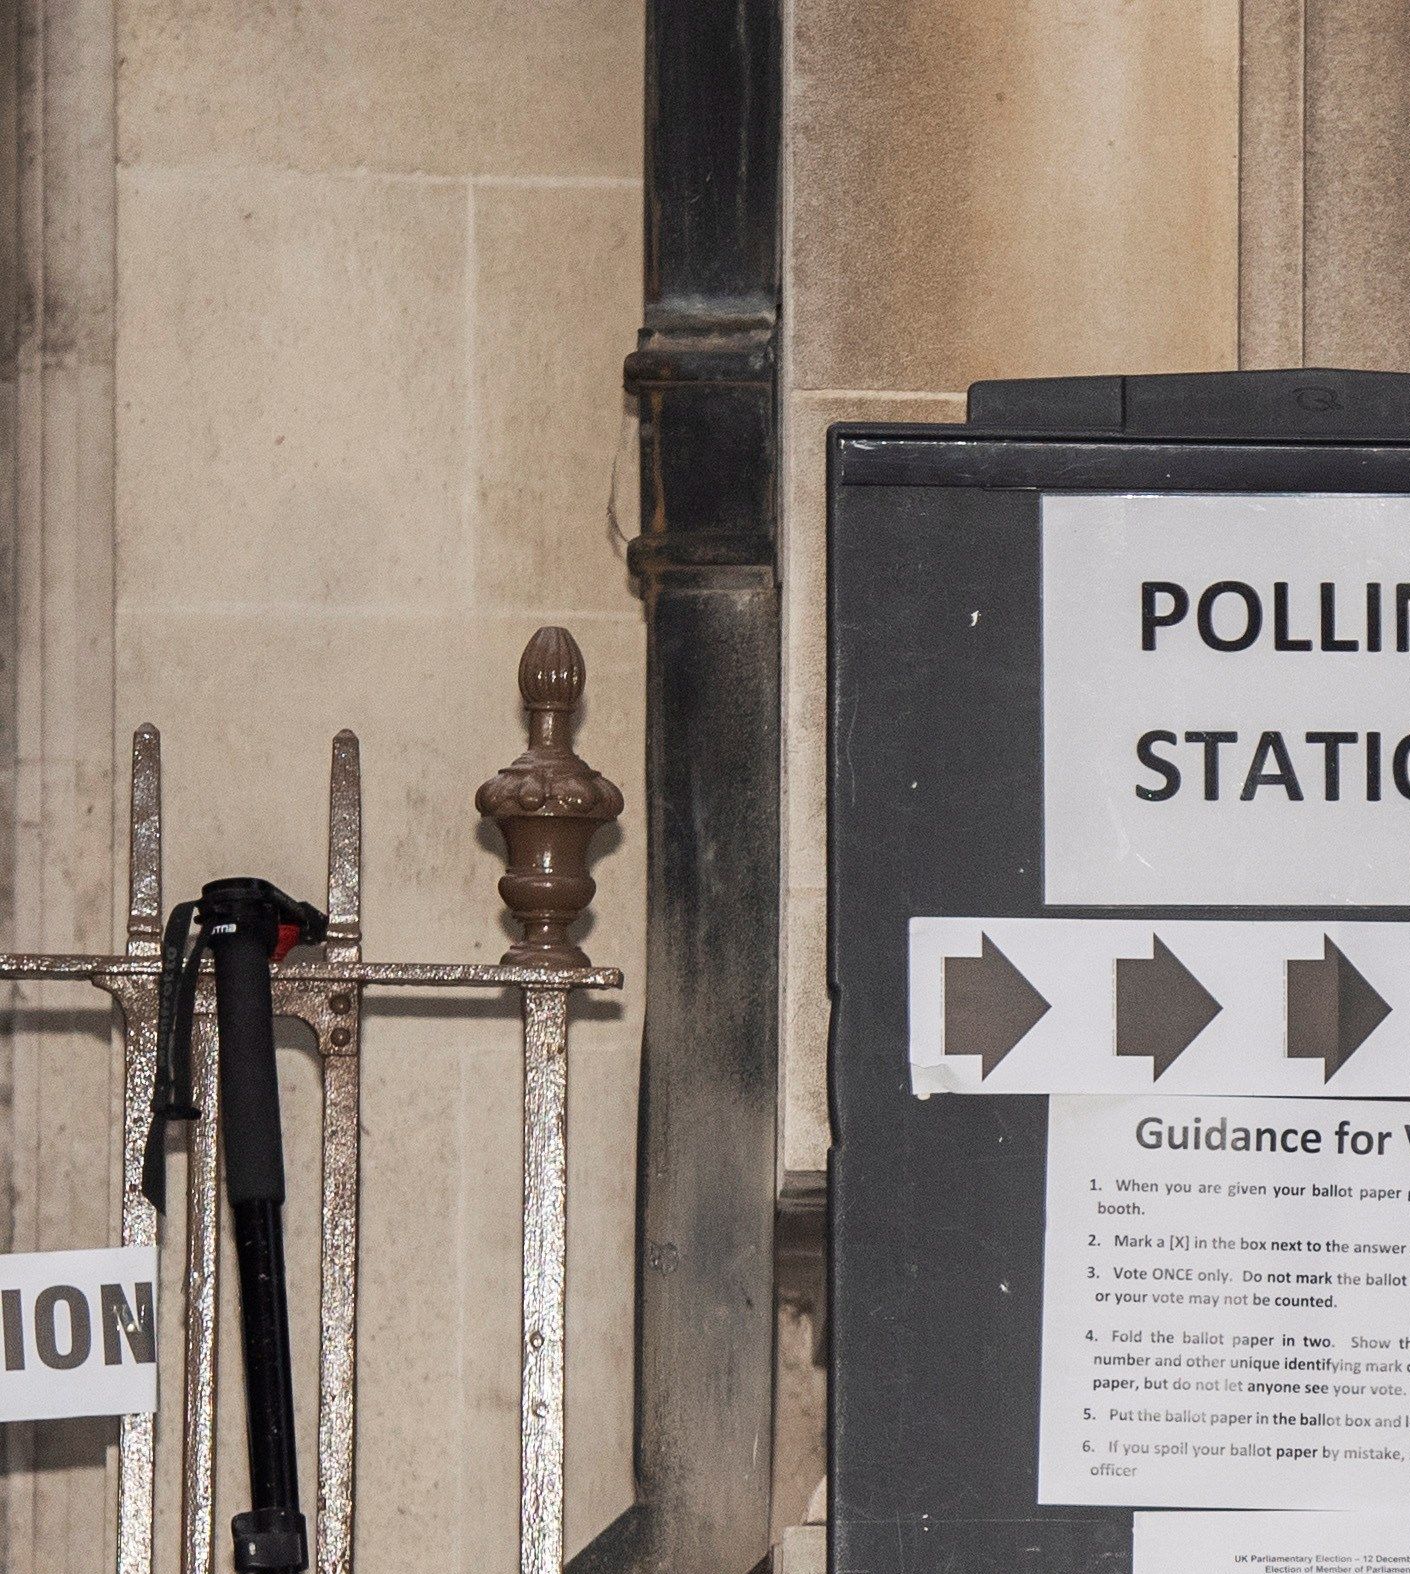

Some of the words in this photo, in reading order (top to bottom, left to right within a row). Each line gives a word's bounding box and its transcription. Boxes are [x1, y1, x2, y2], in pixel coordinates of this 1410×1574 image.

[1135, 1116, 1322, 1154] Guidance
[1334, 1120, 1393, 1156] for
[1090, 1178, 1102, 1191] 1.
[1115, 1179, 1159, 1193] When
[1165, 1183, 1192, 1196] you
[1198, 1183, 1222, 1194] are
[1227, 1184, 1267, 1197] given
[1273, 1185, 1306, 1198] your
[1312, 1183, 1353, 1198] ballot
[1359, 1188, 1402, 1202] paper
[1097, 1201, 1145, 1215] booth.
[1088, 1233, 1101, 1247] 2.
[1114, 1234, 1152, 1248] Mark
[1156, 1238, 1165, 1248] a
[1169, 1234, 1190, 1252] [X]
[1194, 1236, 1208, 1249] in
[1211, 1236, 1236, 1250] the
[1240, 1237, 1267, 1251] box
[1271, 1240, 1303, 1252] next
[1306, 1240, 1322, 1253] to
[1325, 1239, 1350, 1253] the
[1353, 1243, 1407, 1255] answer
[1087, 1265, 1100, 1279] 3.
[1113, 1267, 1148, 1280] Vote
[1152, 1267, 1193, 1281] ONCE
[1197, 1268, 1233, 1285] only.
[1242, 1269, 1263, 1283] Do
[1267, 1272, 1291, 1284] not
[1295, 1271, 1332, 1285] mark
[1337, 1273, 1361, 1286] the
[1365, 1273, 1407, 1287] ballot
[1094, 1292, 1111, 1303] or
[1114, 1292, 1148, 1305] your
[1152, 1292, 1185, 1305] vote
[1188, 1294, 1220, 1308] may
[1224, 1294, 1248, 1306] not
[1252, 1293, 1271, 1307] be
[1274, 1295, 1337, 1308] counted.
[0, 1282, 157, 1372] ION
[1085, 1329, 1098, 1342] 4.
[1112, 1329, 1143, 1344] Fold
[1150, 1330, 1175, 1344] the
[1182, 1331, 1225, 1346] ballot
[1232, 1335, 1275, 1349] paper
[1282, 1334, 1296, 1347] in
[1303, 1336, 1335, 1348] two.
[1351, 1335, 1391, 1349] Show
[1093, 1353, 1151, 1367] number
[1154, 1355, 1182, 1368] and
[1185, 1355, 1226, 1369] other
[1230, 1356, 1280, 1372] unique
[1284, 1357, 1362, 1375] identifying
[1365, 1359, 1402, 1373] mark
[1092, 1378, 1140, 1391] paper,
[1143, 1376, 1168, 1390] but
[1172, 1378, 1192, 1391] do
[1195, 1379, 1220, 1392] not
[1224, 1378, 1243, 1392] let
[1247, 1382, 1301, 1395] anyone
[1304, 1383, 1329, 1395] see
[1333, 1385, 1366, 1397] your
[1370, 1384, 1407, 1396] vote.
[1083, 1407, 1096, 1421] 5.
[1109, 1408, 1134, 1422] Put
[1137, 1409, 1161, 1423] the
[1164, 1409, 1207, 1424] ballot
[1210, 1413, 1253, 1427] paper
[1255, 1411, 1269, 1425] in
[1272, 1412, 1297, 1426] the
[1299, 1412, 1341, 1427] ballot
[1344, 1414, 1371, 1428] box
[1374, 1415, 1402, 1429] and
[1082, 1439, 1095, 1453] 6.
[1108, 1440, 1119, 1453] If
[1123, 1444, 1150, 1456] you
[1154, 1441, 1189, 1457] spoil
[1192, 1445, 1226, 1458] your
[1230, 1443, 1272, 1457] ballot
[1276, 1447, 1318, 1461] paper
[1322, 1445, 1340, 1461] by
[1343, 1447, 1405, 1462] mistake,
[1089, 1462, 1138, 1477] officer
[1250, 1554, 1312, 1563] Parliamentary
[1315, 1554, 1352, 1562] Election
[1363, 1554, 1373, 1562] 12
[1264, 1565, 1301, 1573] Election
[1303, 1565, 1313, 1573] of
[1315, 1565, 1351, 1573] Member
[1354, 1565, 1363, 1573] of
